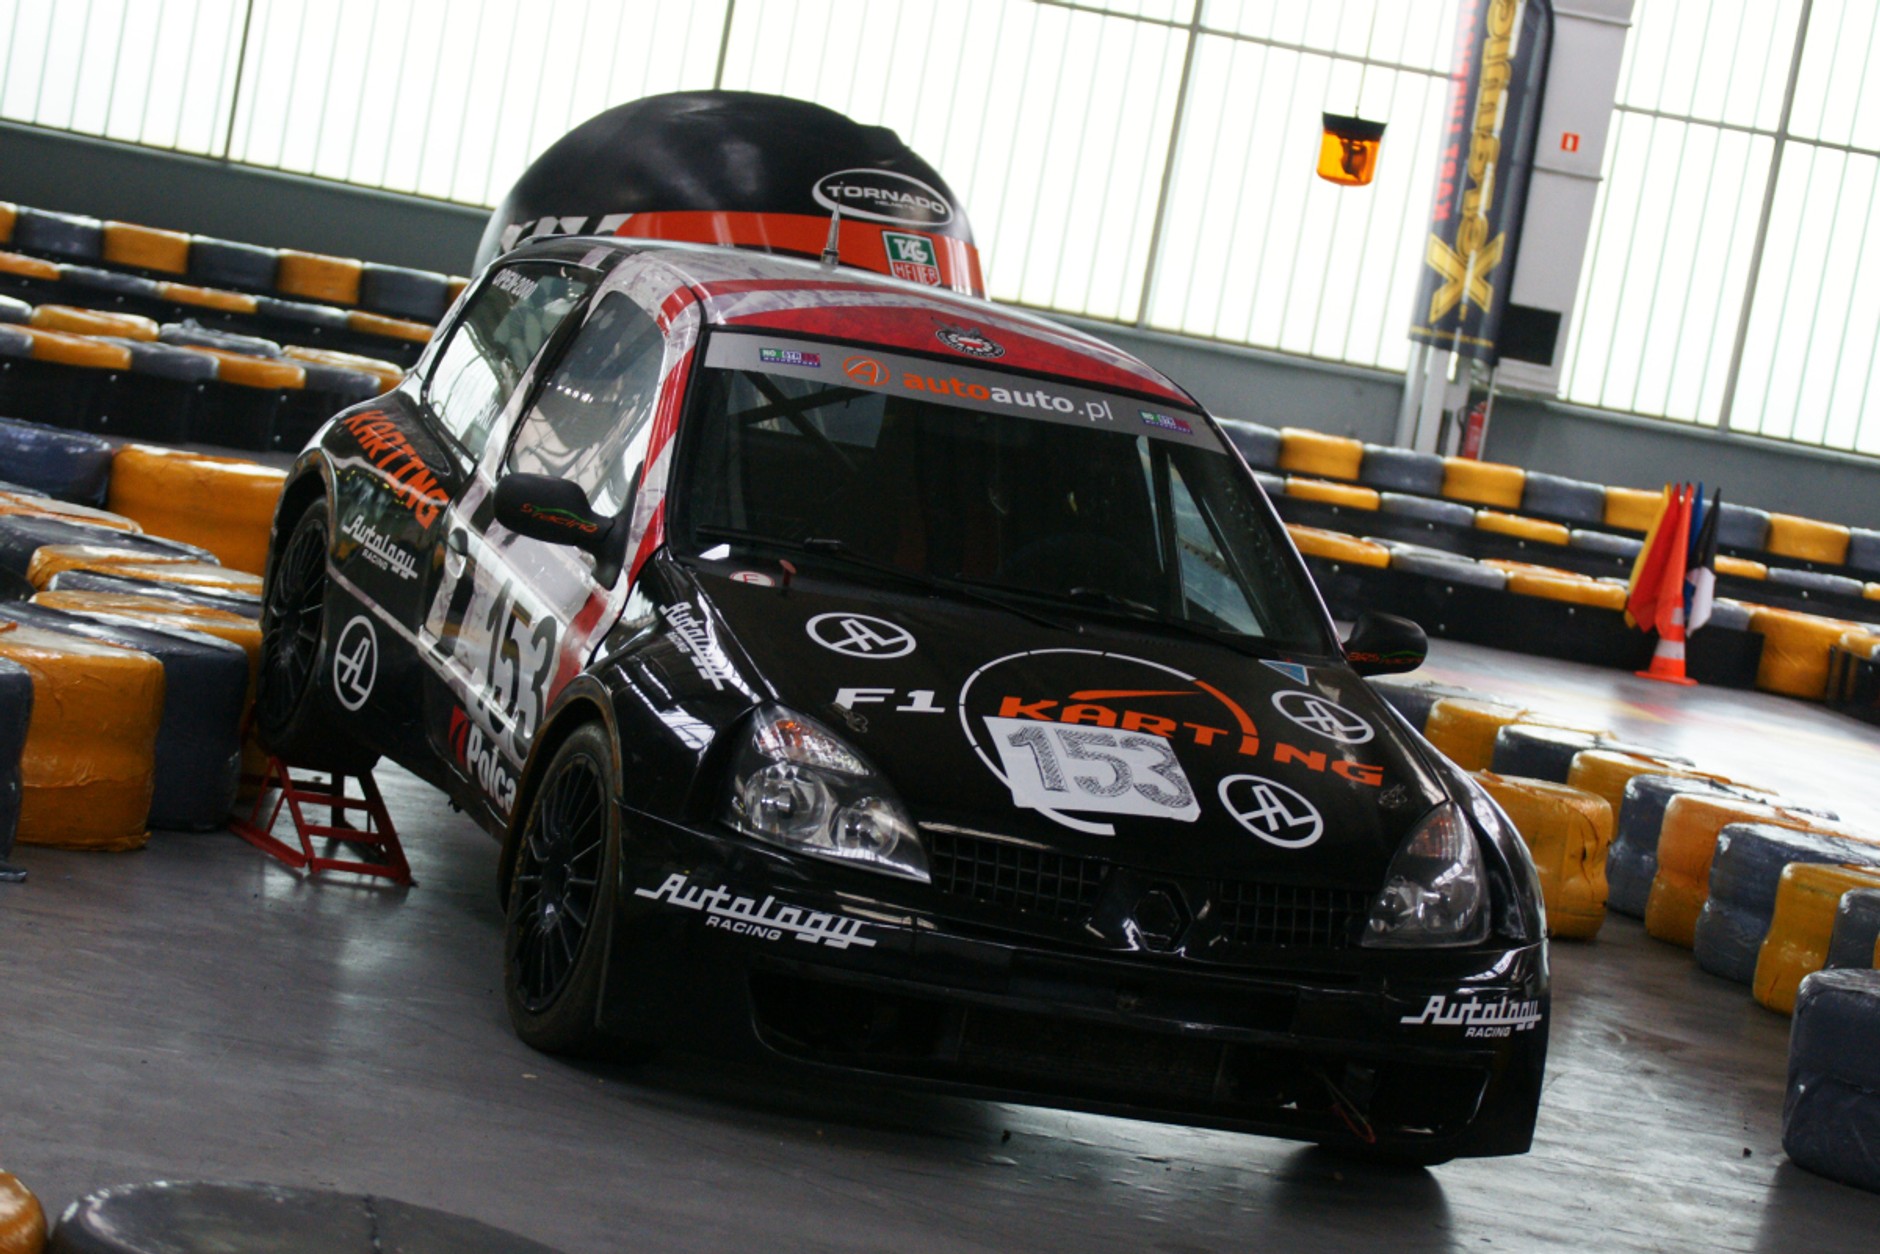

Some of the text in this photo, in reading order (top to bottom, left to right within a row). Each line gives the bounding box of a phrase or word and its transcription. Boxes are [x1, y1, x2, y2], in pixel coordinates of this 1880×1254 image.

[827, 185, 946, 215] TORNADO
[893, 238, 929, 263] TAG
[903, 372, 1114, 422] autoauto.pl
[344, 409, 450, 530] KARTING
[341, 514, 418, 580] Autology
[362, 548, 389, 571] RACING
[477, 577, 557, 761] 153
[833, 688, 1385, 788] F1 KARTING
[1006, 725, 1195, 809] 153
[634, 873, 877, 950] Autology
[705, 915, 783, 941] RACING
[1400, 995, 1543, 1031] Autology
[1465, 1026, 1512, 1038] RACING
